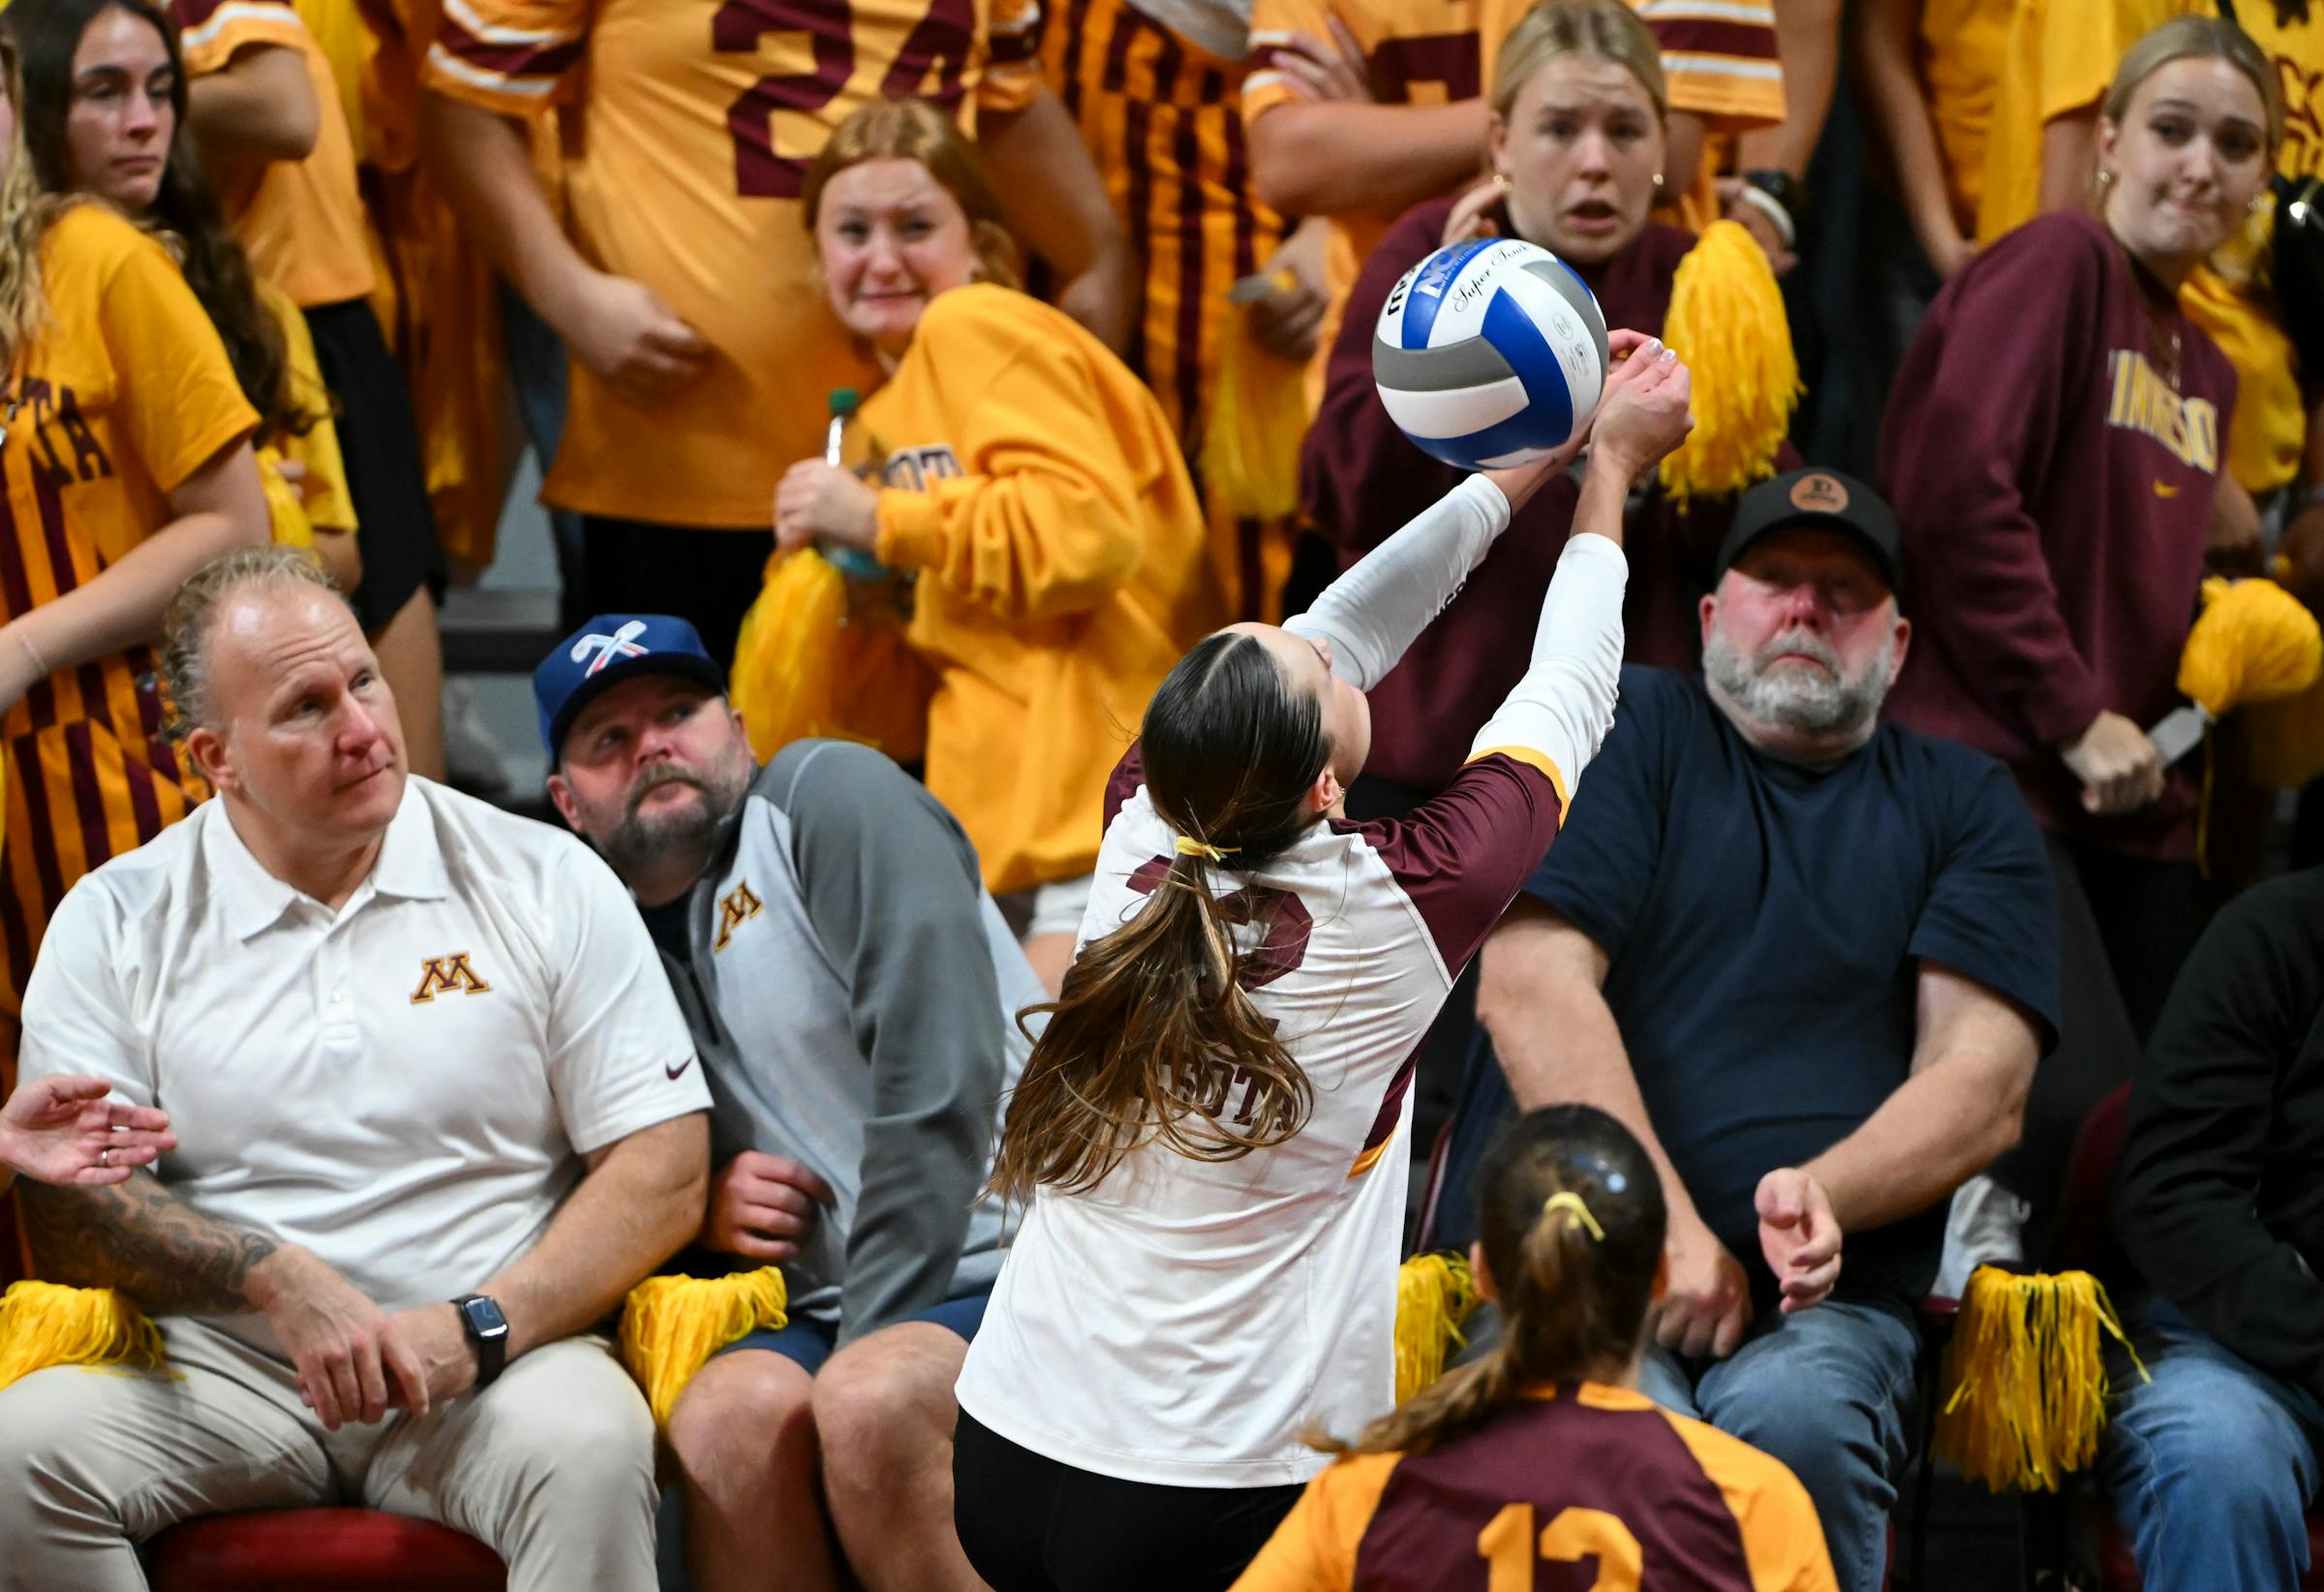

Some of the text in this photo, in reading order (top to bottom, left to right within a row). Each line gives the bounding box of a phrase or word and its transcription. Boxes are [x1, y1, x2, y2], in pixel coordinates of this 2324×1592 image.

[1453, 268, 1491, 313] Super
[714, 877, 764, 953] M
[410, 950, 492, 1004] M
